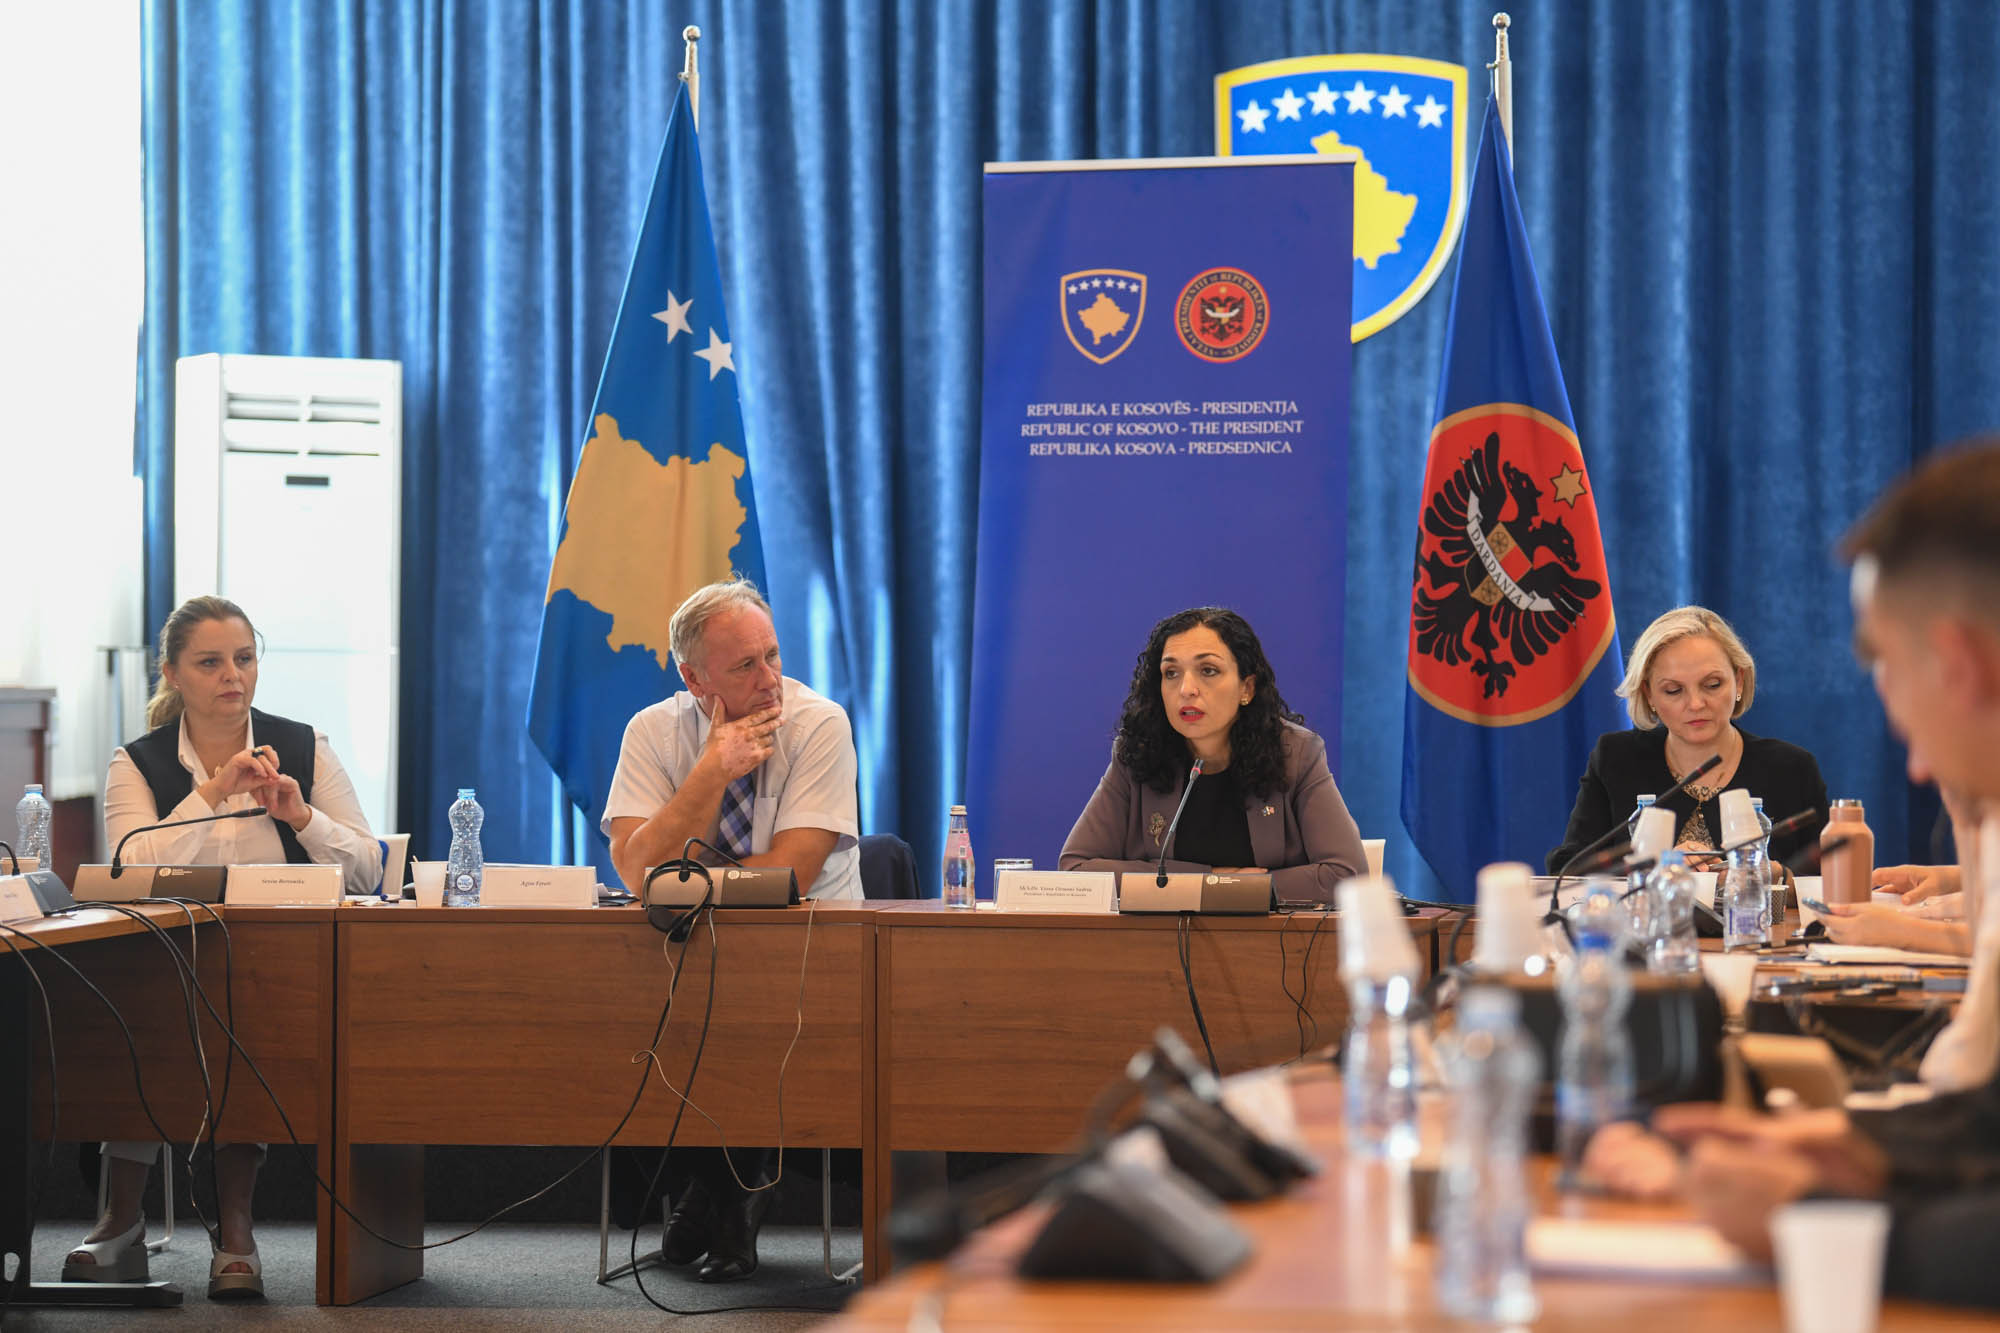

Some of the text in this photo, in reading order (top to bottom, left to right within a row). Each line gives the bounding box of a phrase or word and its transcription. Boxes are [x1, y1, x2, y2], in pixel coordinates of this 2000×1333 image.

[1027, 403, 1107, 416] REPUBLIKA
[1111, 403, 1120, 415] E
[1124, 400, 1191, 415] KOSOVËS
[1202, 400, 1298, 415] PRESIDENTJA
[1021, 422, 1090, 436] REPUBLIC
[1093, 422, 1113, 435] OF
[1117, 421, 1179, 435] KOSOVO
[1190, 421, 1220, 434] THE
[1224, 419, 1304, 434] PRESIDENT
[1030, 443, 1111, 456] REPUBLIKA
[1115, 442, 1176, 455] KOSOVA
[1189, 440, 1292, 454] PREDSEDNICA
[1471, 528, 1522, 605] DARDANIA
